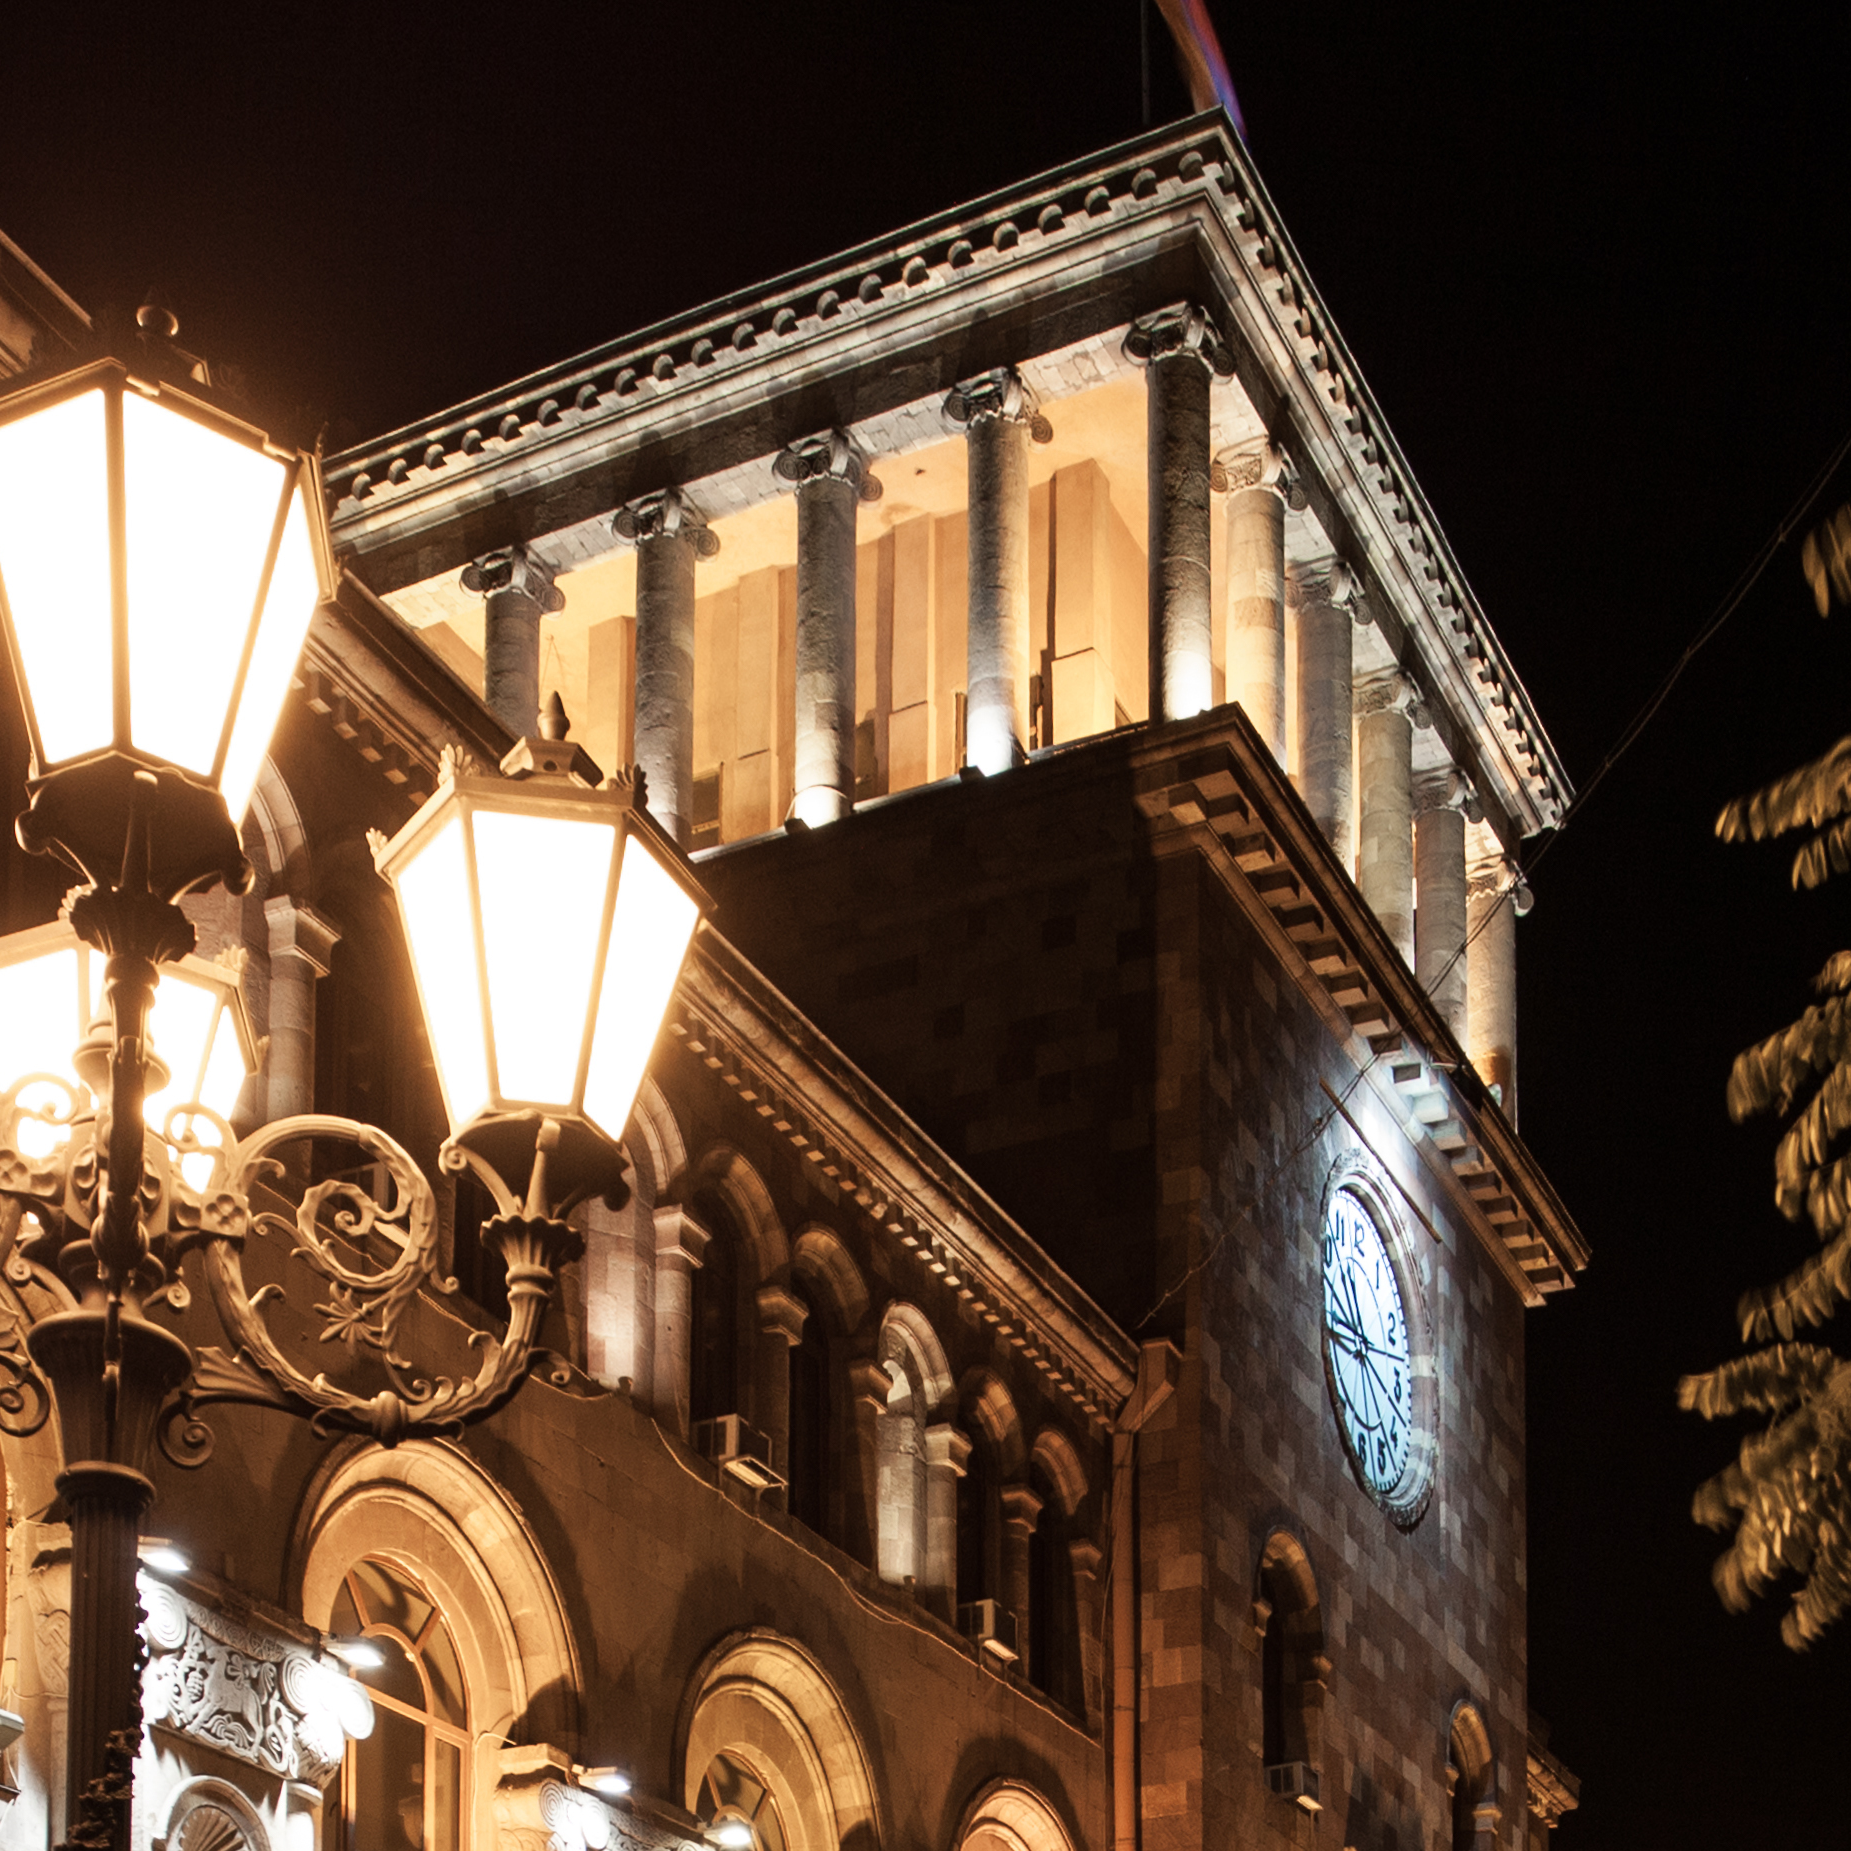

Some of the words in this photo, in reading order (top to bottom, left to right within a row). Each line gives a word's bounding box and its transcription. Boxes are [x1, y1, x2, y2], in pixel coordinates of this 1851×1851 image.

[1335, 1209, 1345, 1247] 11
[1388, 1311, 1396, 1347] 2
[1394, 1366, 1402, 1404] 3
[1390, 1415, 1398, 1452] 4
[1377, 1437, 1386, 1477] 5
